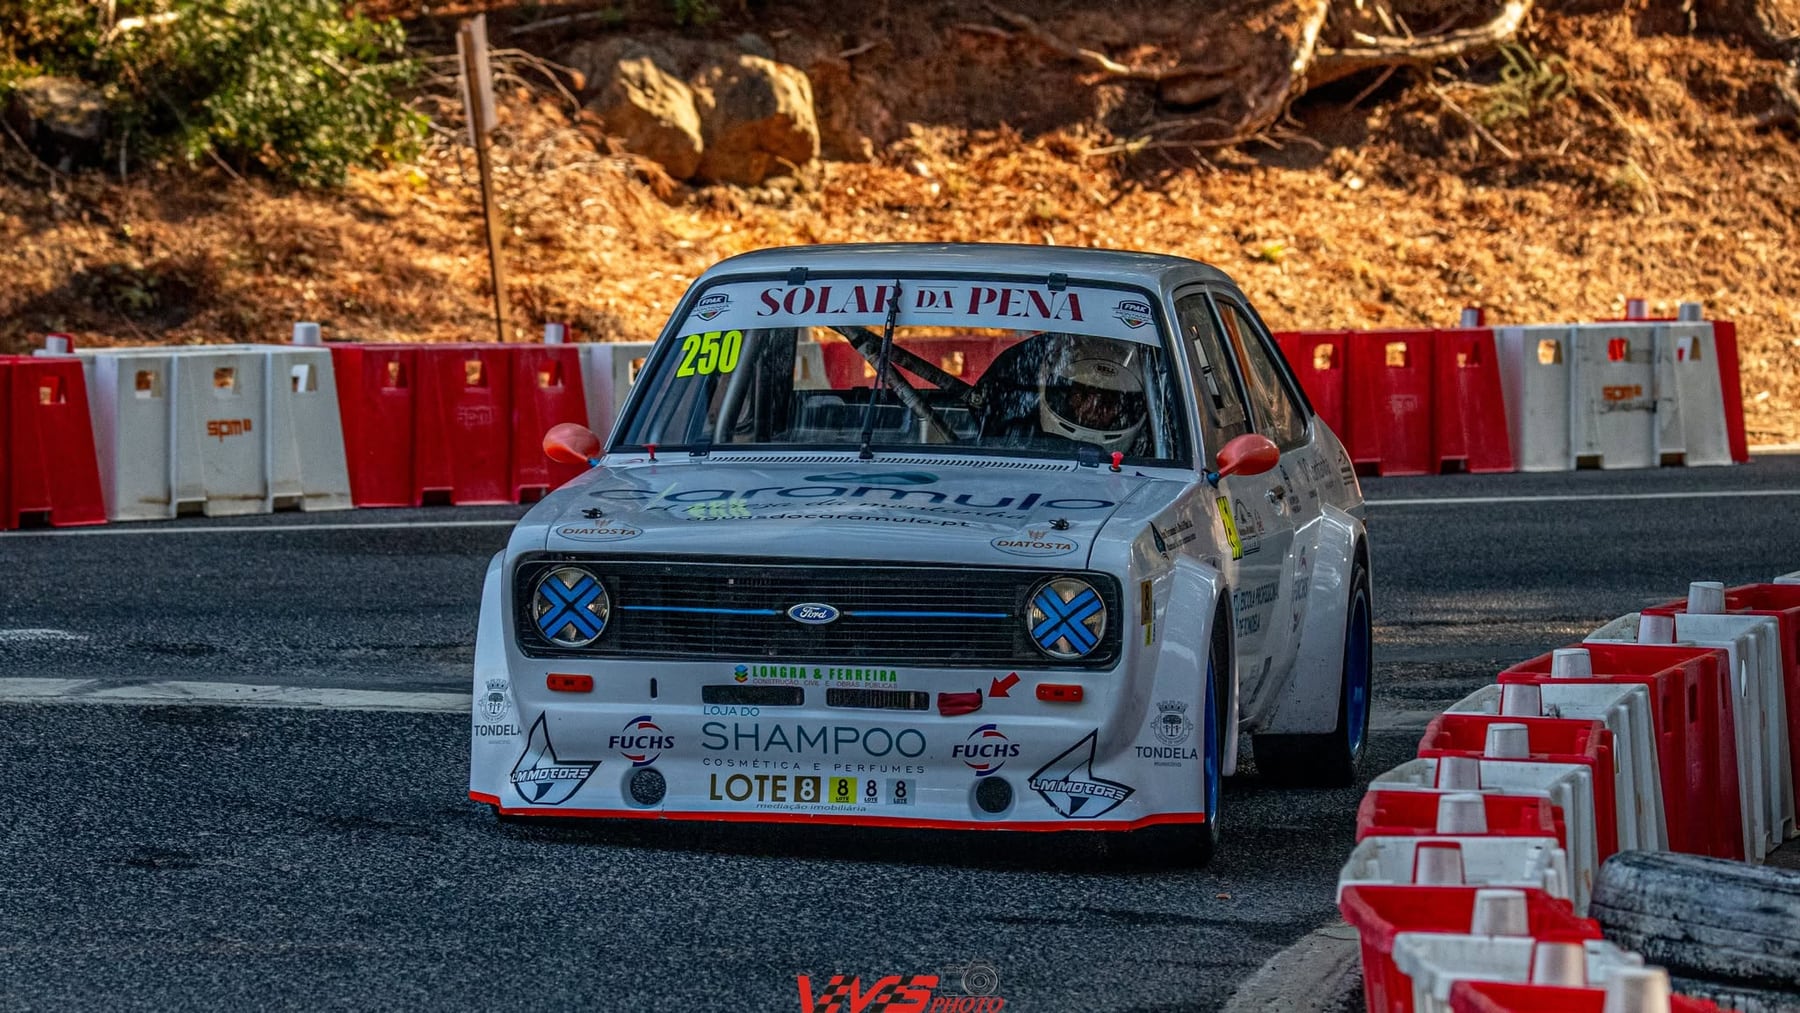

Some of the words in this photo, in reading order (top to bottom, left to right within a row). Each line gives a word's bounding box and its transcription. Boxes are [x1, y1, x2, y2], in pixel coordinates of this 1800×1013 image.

[756, 285, 903, 317] SOLAR
[914, 289, 954, 309] DA
[966, 286, 1085, 322] PENA
[676, 329, 744, 378] 250
[207, 419, 243, 443] spm
[588, 486, 1115, 510] caramulo
[562, 527, 637, 537] DIATOSTA
[996, 539, 1072, 551] DIATOSTA
[799, 606, 828, 619] Ford
[752, 665, 807, 679] LONGRA
[813, 668, 823, 680] &
[829, 667, 897, 682] FERREIRA
[703, 705, 738, 716] LOJA
[740, 706, 760, 717] DO
[608, 735, 675, 749] FUCHS
[701, 722, 927, 758] SHAMPOO
[952, 744, 1020, 758] FUCHS
[1135, 746, 1199, 760] TONDELA
[702, 758, 801, 769] COSMÉTICA
[813, 763, 821, 771] E
[834, 763, 925, 774] PERFUMES
[510, 771, 528, 783] LM
[527, 768, 591, 782] MOTORS
[709, 773, 787, 802] LOTE
[799, 777, 816, 802] 8
[837, 778, 849, 797] 8
[865, 779, 878, 798] 8
[895, 780, 907, 799] 8
[1029, 779, 1058, 793] LM
[1057, 780, 1127, 801] MOTORS
[756, 802, 808, 812] mediação
[809, 803, 867, 813] imobiliária
